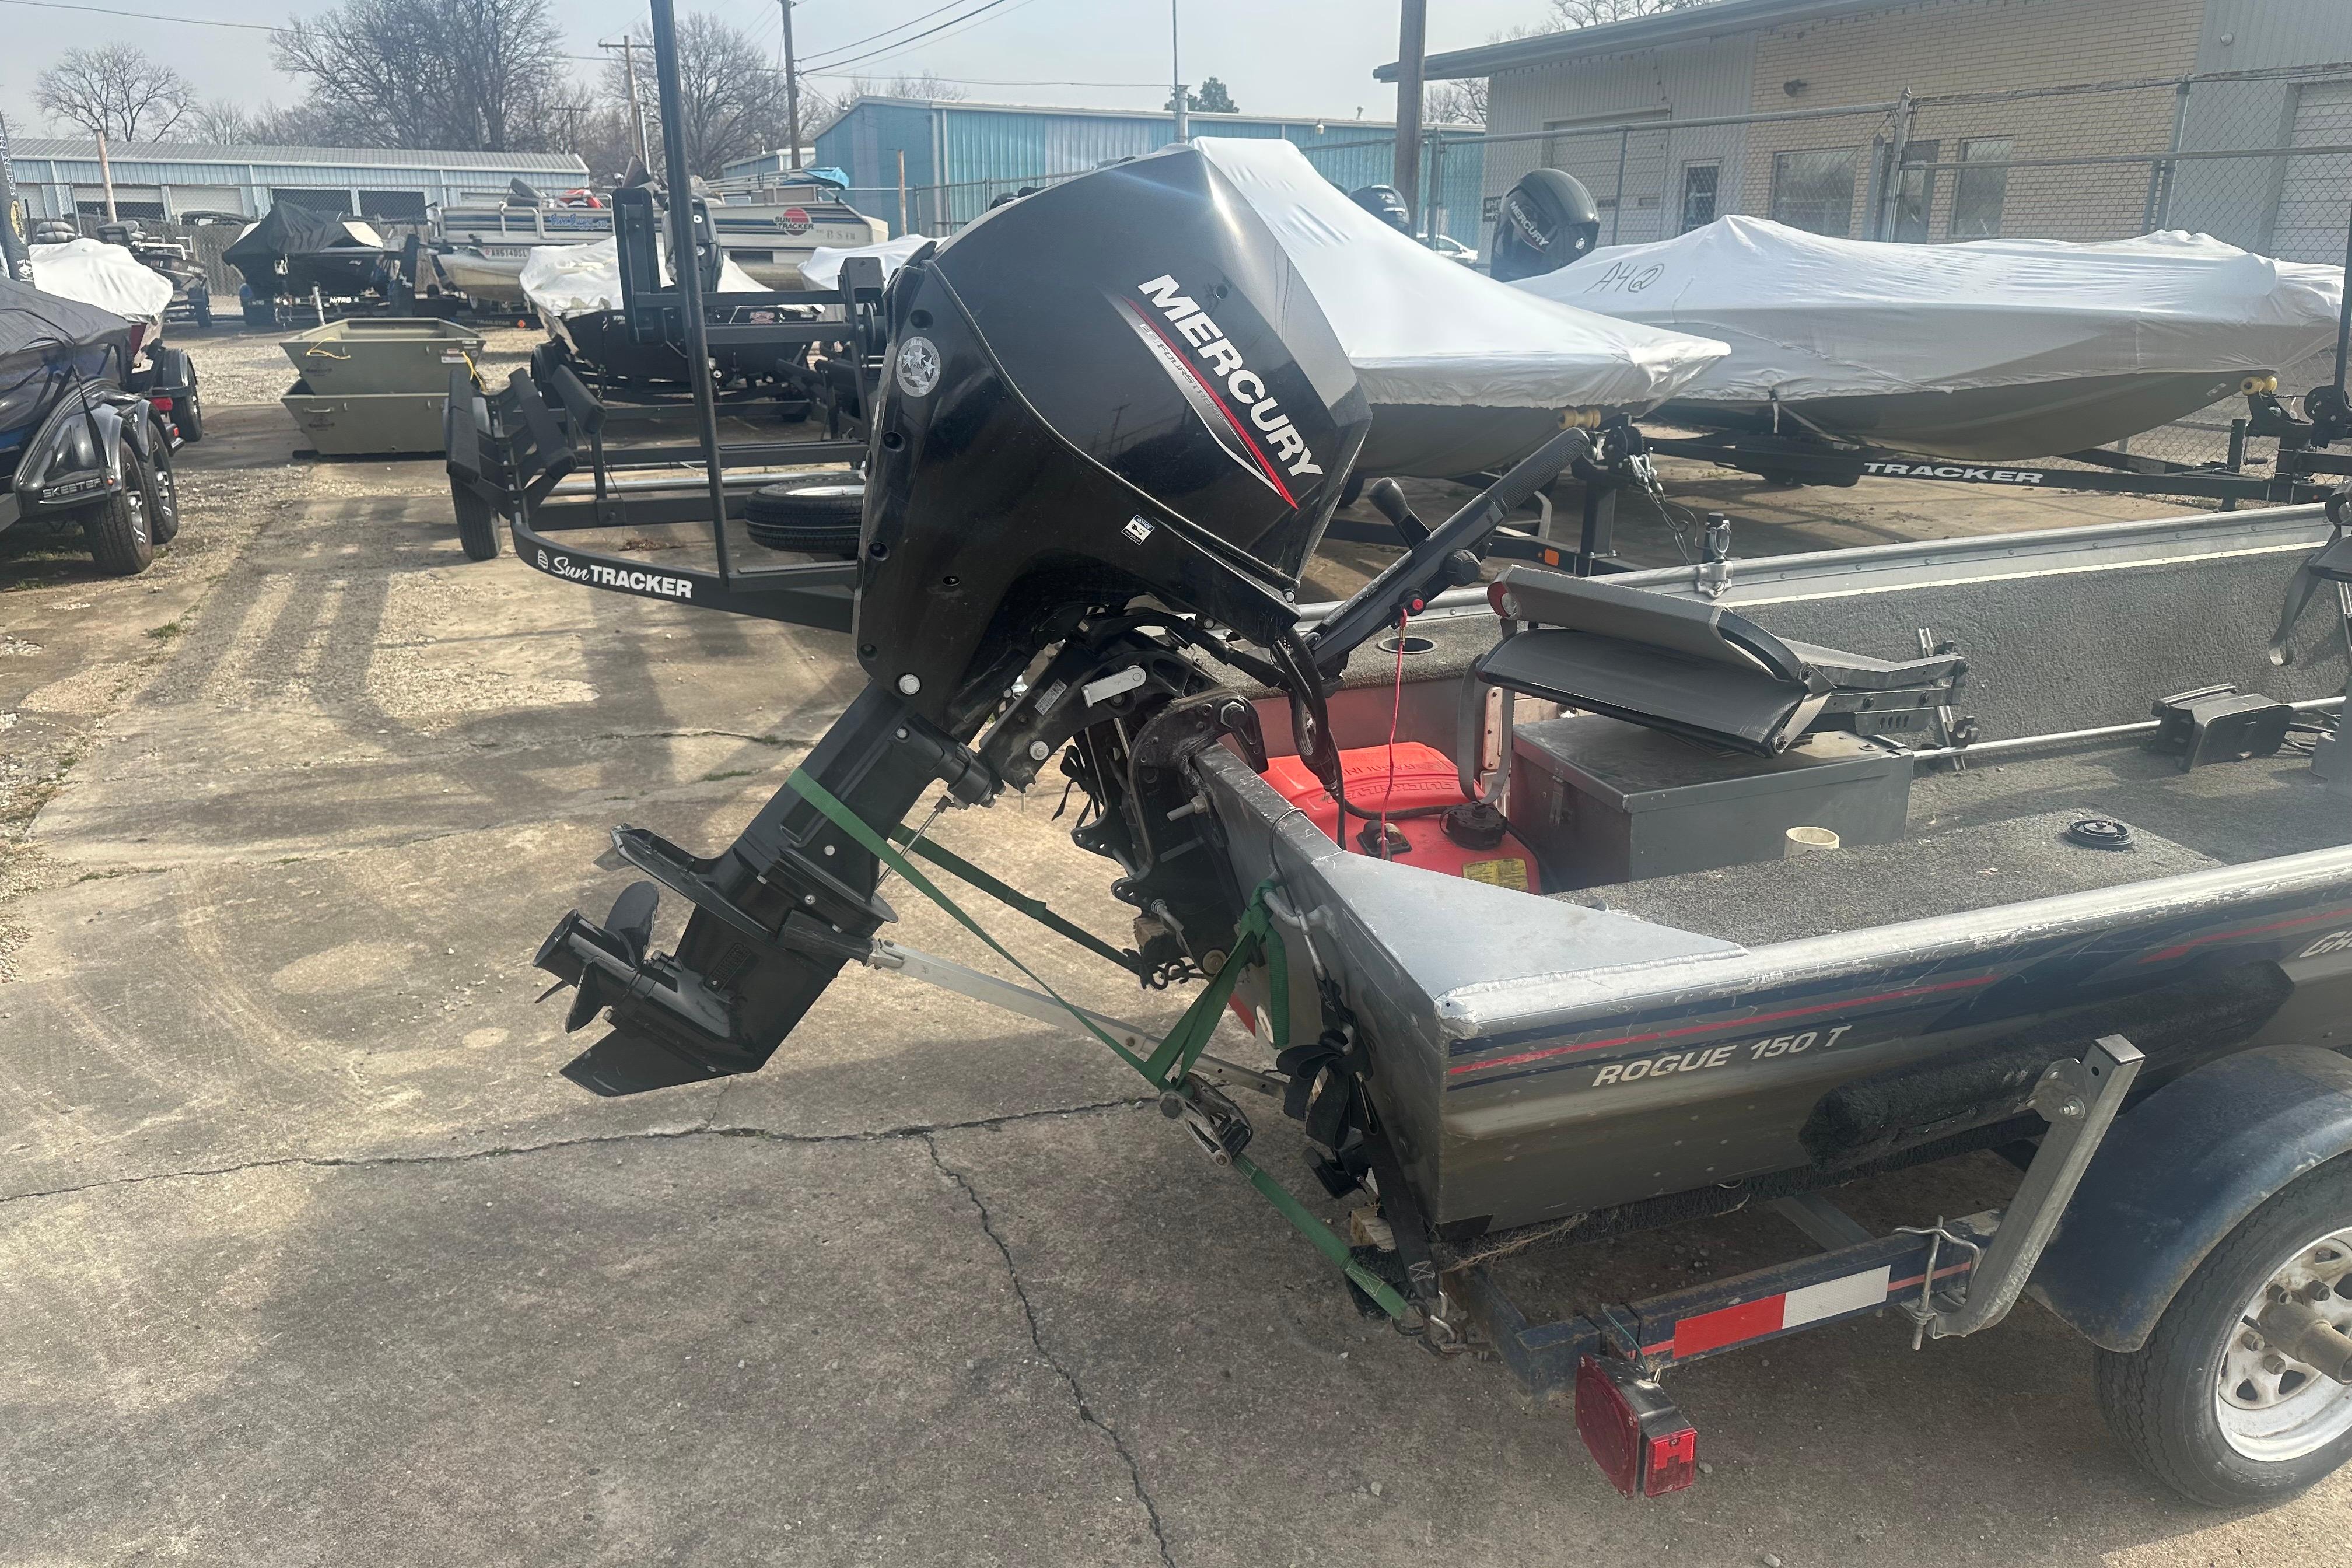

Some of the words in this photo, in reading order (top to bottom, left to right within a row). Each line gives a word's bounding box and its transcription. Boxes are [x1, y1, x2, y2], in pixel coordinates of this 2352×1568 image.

[1509, 201, 1550, 246] MERCURY
[1138, 274, 1323, 477] MERCURY
[1139, 323, 1160, 347] EFI
[1158, 342, 1225, 421] FOURSTROKE
[43, 478, 102, 498] SKEETER
[1864, 462, 2044, 484] TRACKER
[1136, 517, 1152, 529] NOTICE
[551, 556, 589, 581] Sun
[590, 565, 692, 598] TRACKER
[1342, 764, 1416, 776] GASOLIN
[1592, 1045, 1737, 1087] ROGUE
[1751, 1031, 1815, 1059] 150
[1825, 1025, 1852, 1047] T
